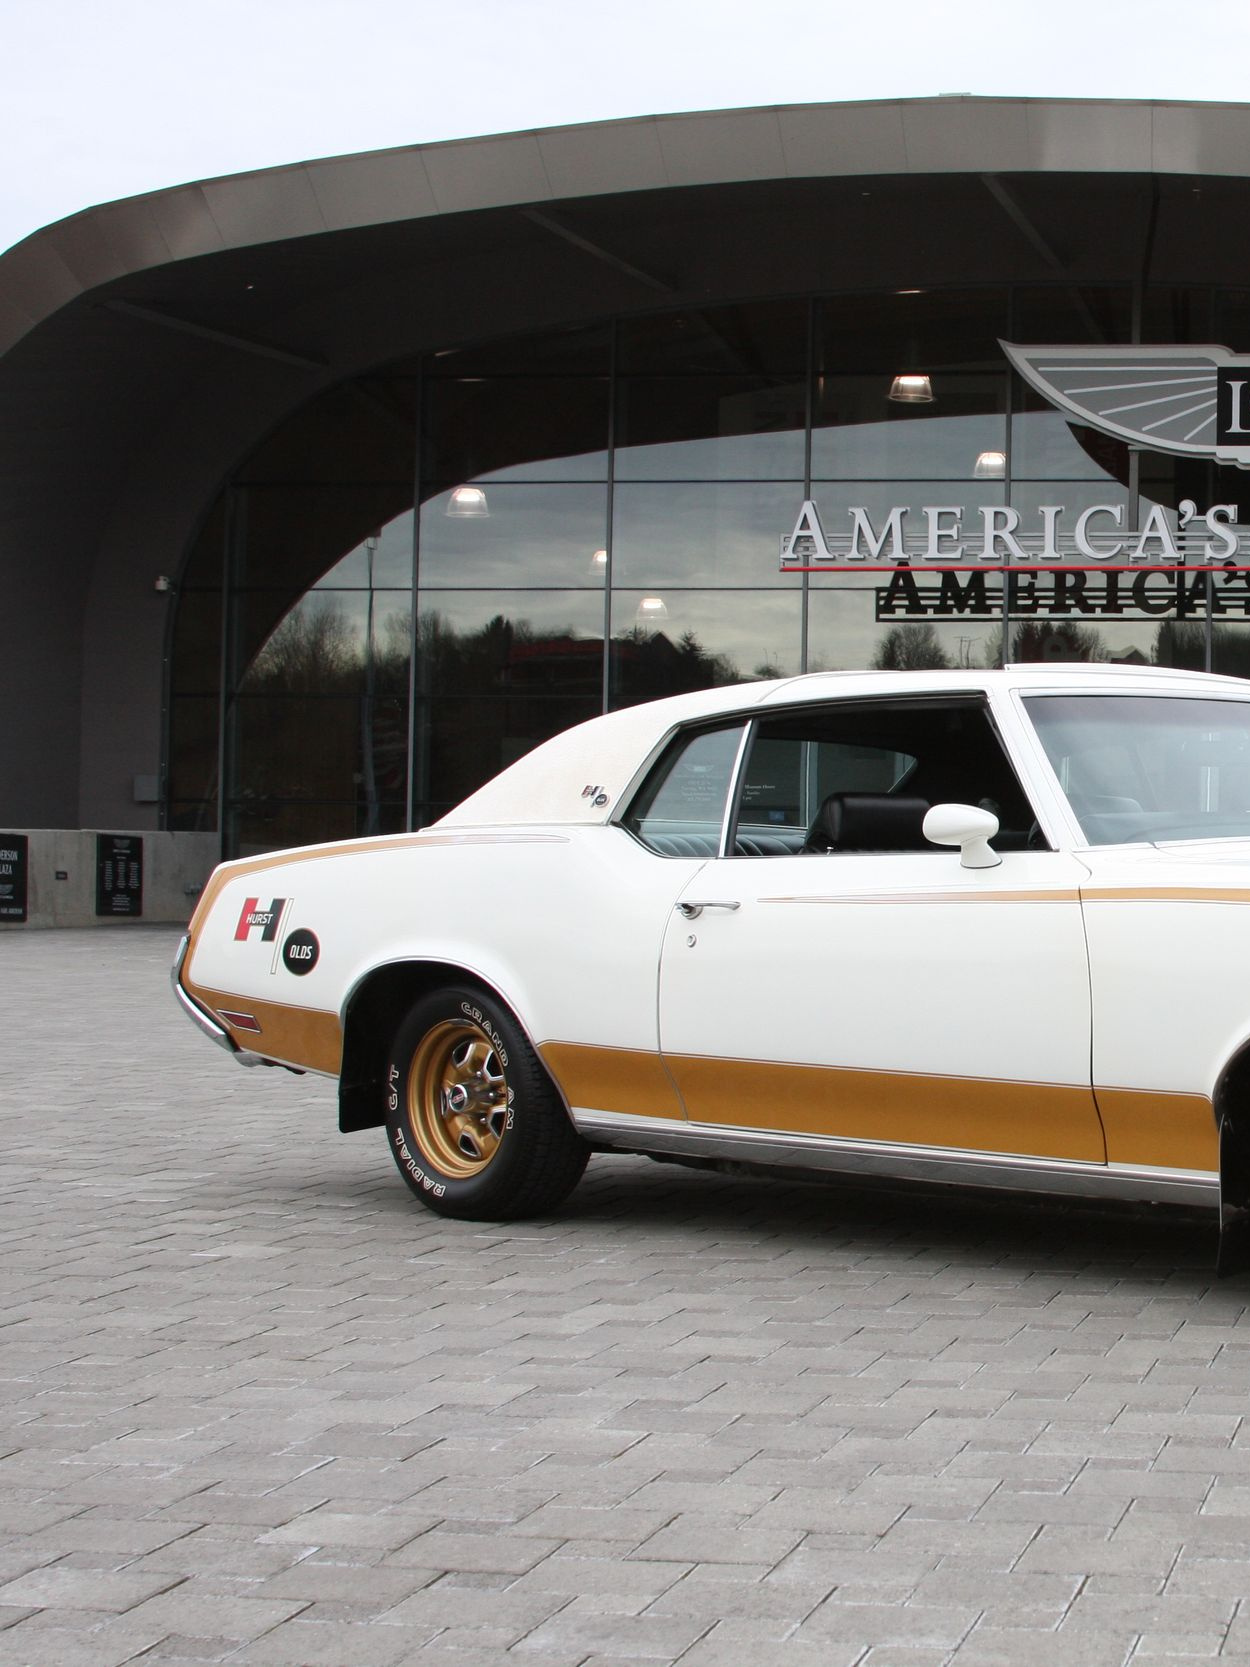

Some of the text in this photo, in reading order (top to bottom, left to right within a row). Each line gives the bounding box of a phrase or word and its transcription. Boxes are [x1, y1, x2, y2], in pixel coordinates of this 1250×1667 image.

[784, 499, 1239, 561] AMERICA'S
[246, 913, 273, 924] HURST
[289, 944, 313, 959] OLDS
[461, 1001, 509, 1067] GRAND
[506, 1086, 515, 1130] AM
[395, 1128, 446, 1198] RADIAL
